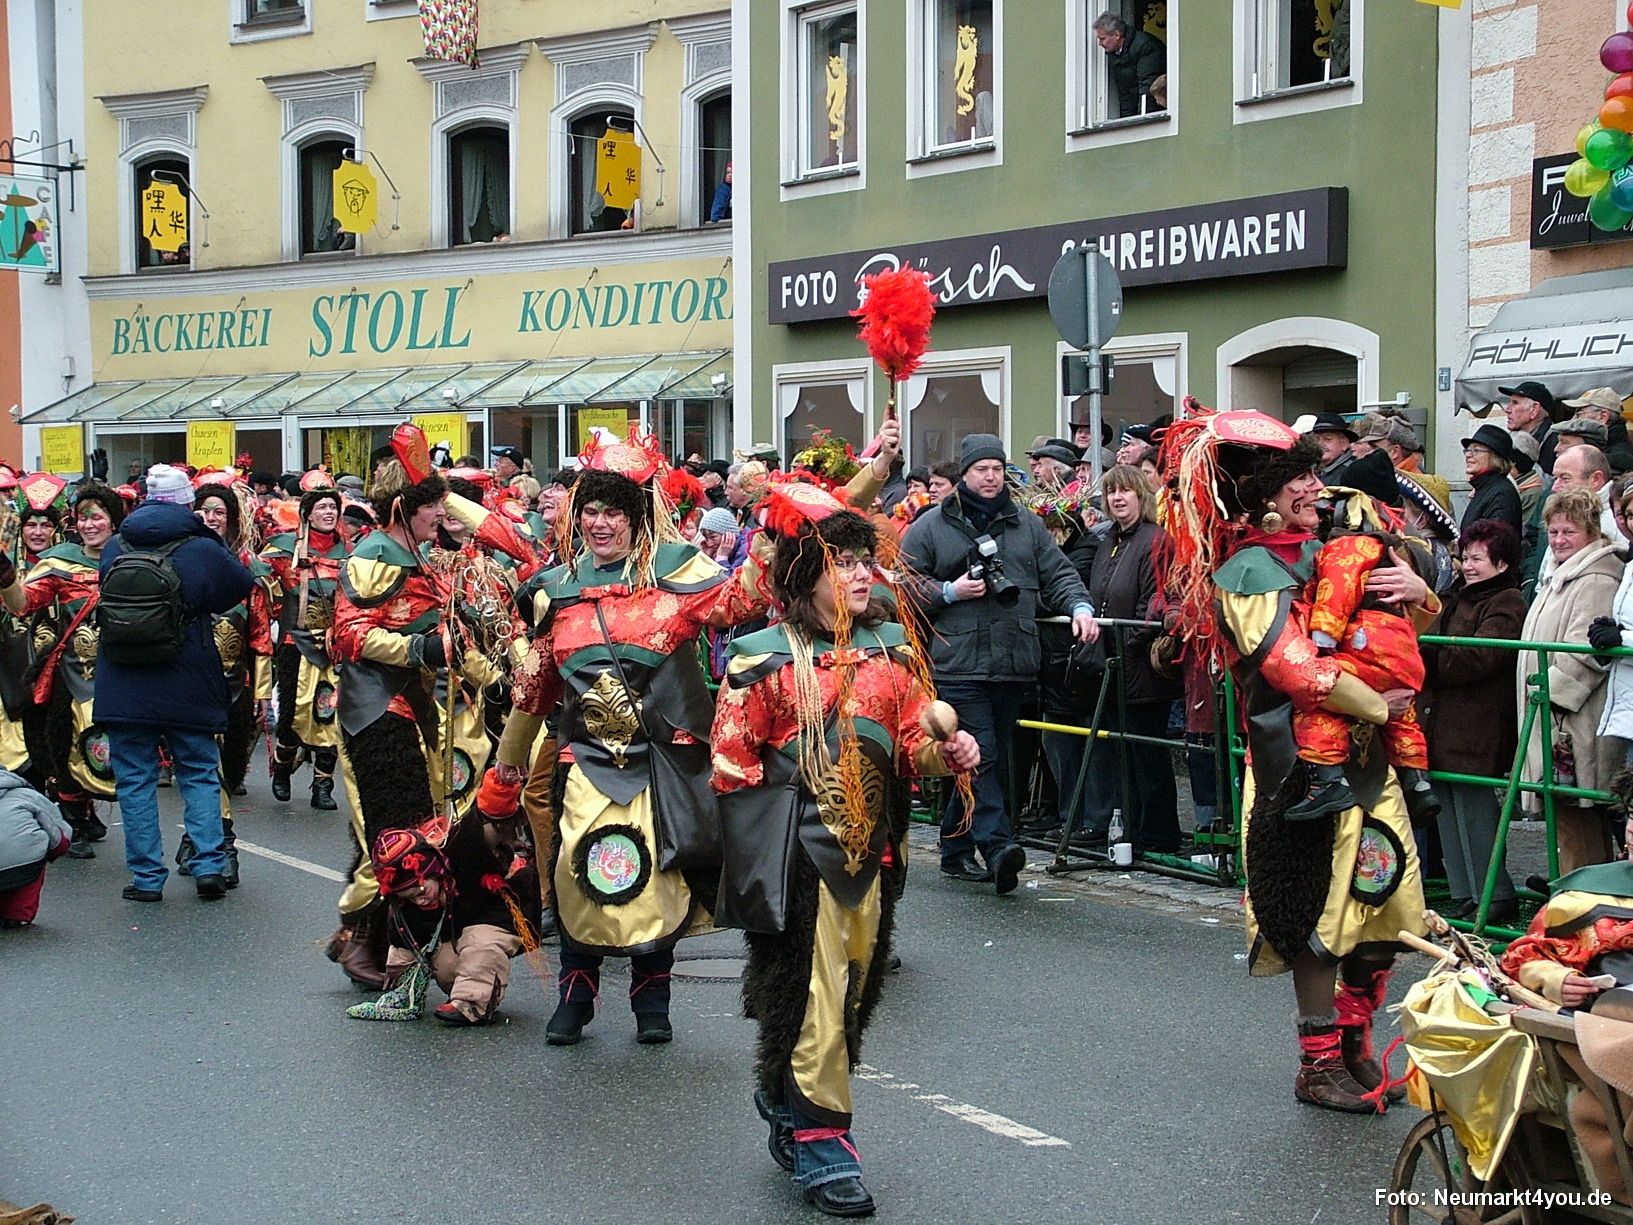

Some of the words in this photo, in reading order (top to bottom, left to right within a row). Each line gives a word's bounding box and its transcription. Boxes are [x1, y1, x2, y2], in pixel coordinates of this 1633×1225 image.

[1539, 190, 1592, 235] Juwel
[781, 270, 837, 309] FOTO
[111, 308, 273, 355] BÄCKEREI
[309, 287, 472, 358] STOLL
[517, 277, 733, 332] KONDITOR
[193, 441, 223, 458] Krapfen
